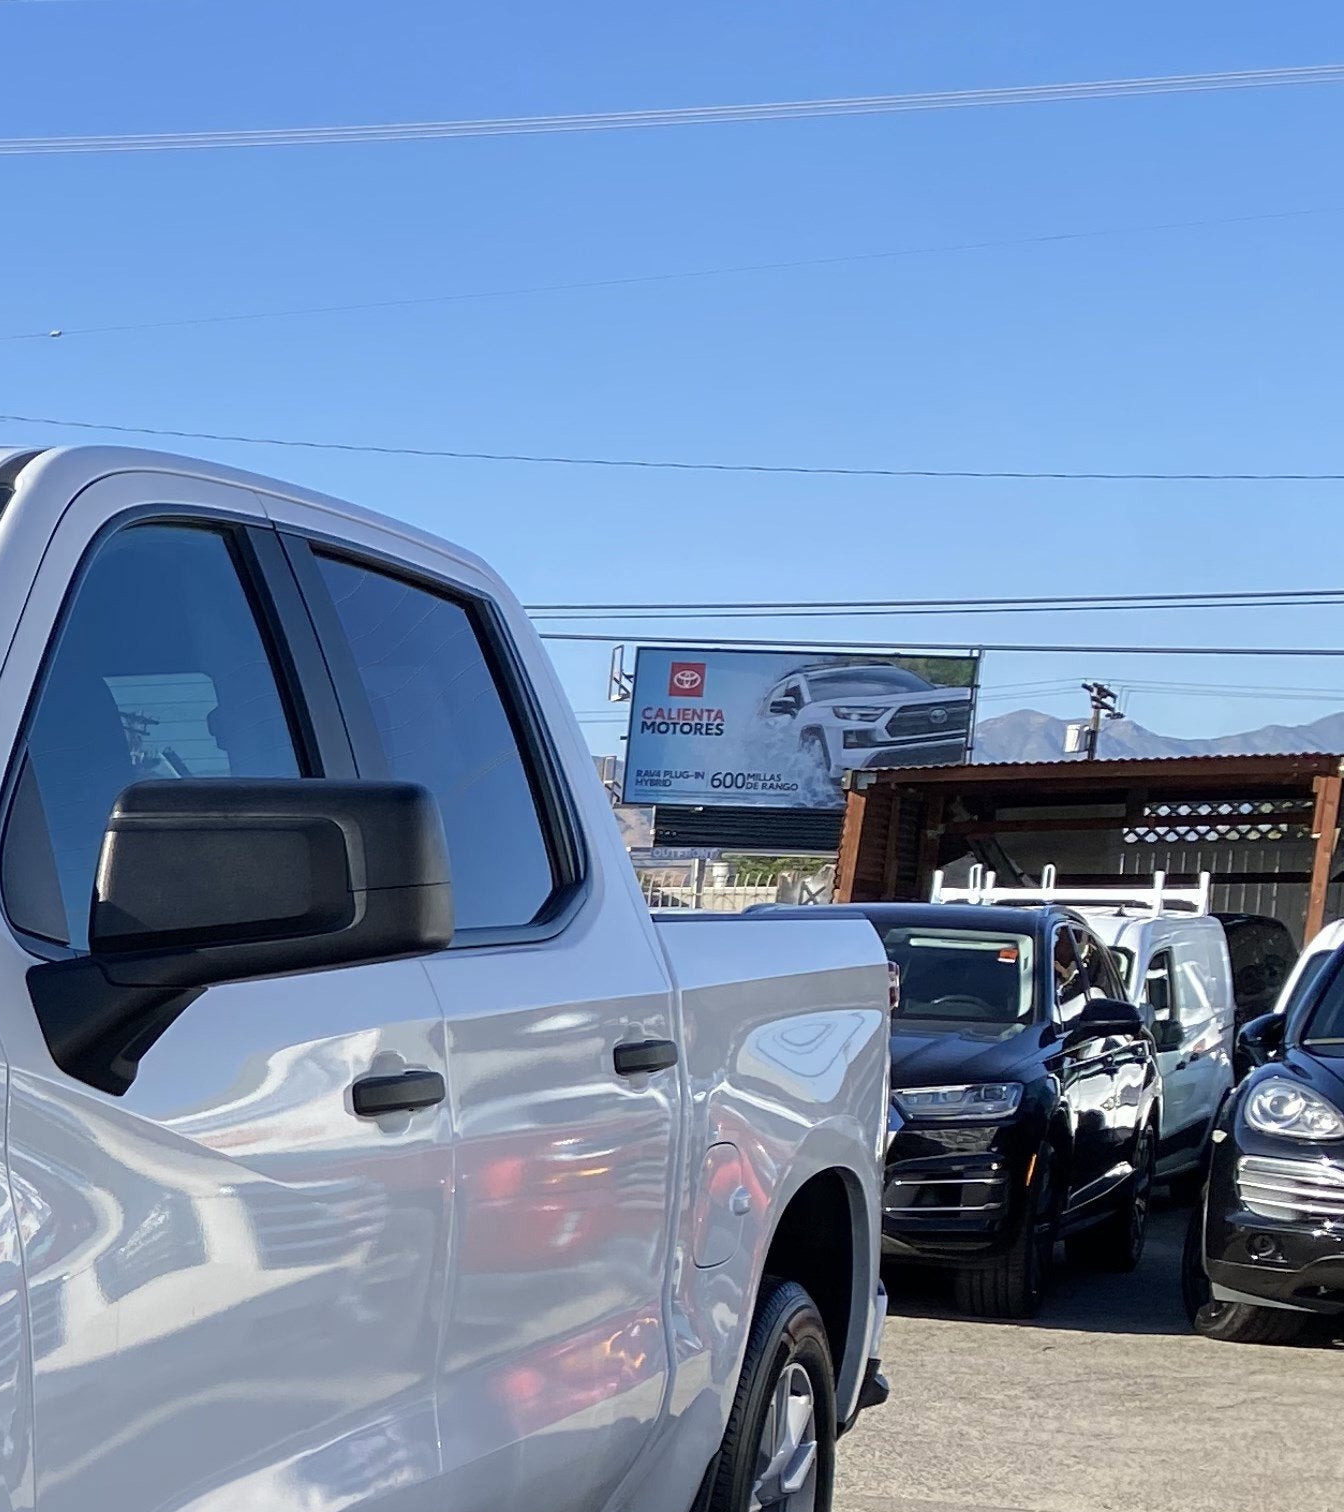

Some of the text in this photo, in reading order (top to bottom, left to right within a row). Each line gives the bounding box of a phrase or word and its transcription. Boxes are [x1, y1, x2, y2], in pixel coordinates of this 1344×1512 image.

[641, 706, 725, 722] CALIENTA
[640, 721, 725, 736] MOTORES
[636, 769, 705, 780] RAV4 PLUG-IN
[710, 771, 746, 789] 600
[746, 773, 782, 782] MILLAS
[635, 778, 672, 787] HYBRID
[745, 782, 799, 791] DE RANGO
